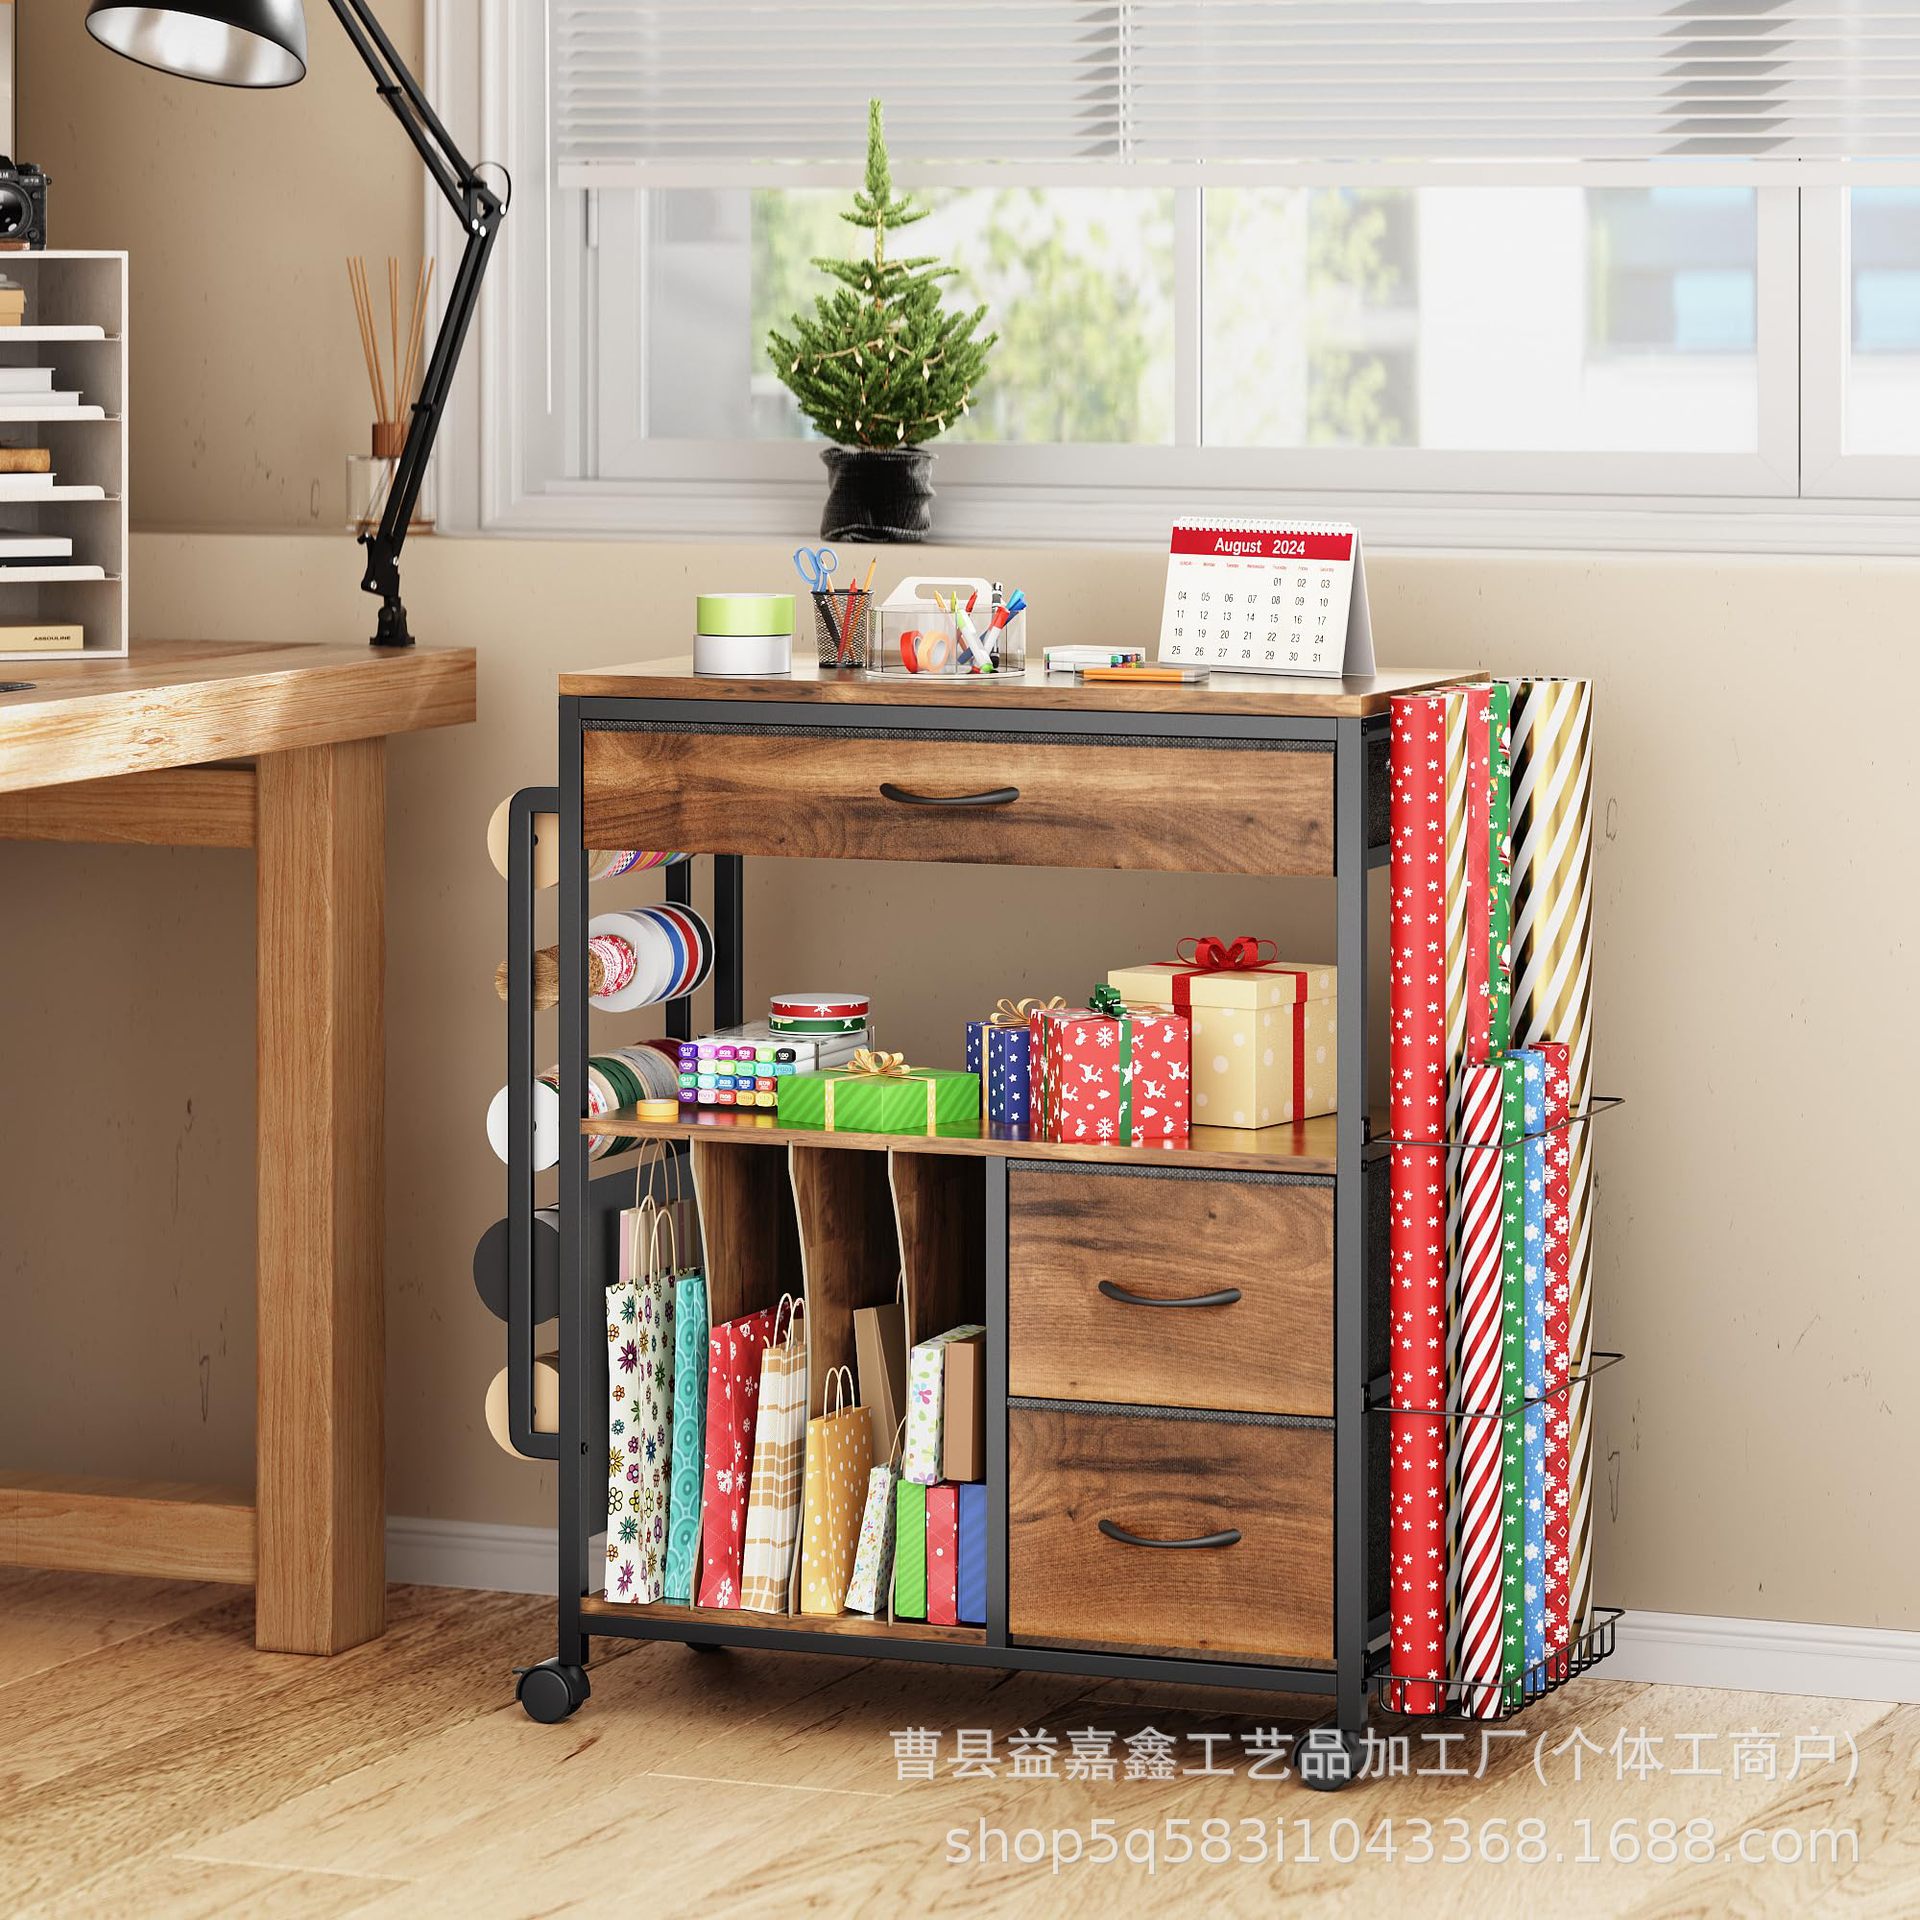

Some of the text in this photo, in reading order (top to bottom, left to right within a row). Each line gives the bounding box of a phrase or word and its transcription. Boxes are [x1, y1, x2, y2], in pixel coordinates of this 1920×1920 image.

[1214, 537, 1306, 555] August 2024
[1273, 578, 1331, 589] 01 02 03
[1177, 591, 1329, 608] 04 05 06 07 08 09 10
[1176, 610, 1327, 626] 11 12 13 14 15 16 17
[1174, 628, 1324, 644] 18 19 20 21 22 23 24
[1171, 646, 1321, 663] 25 26 27 28 29 30 31
